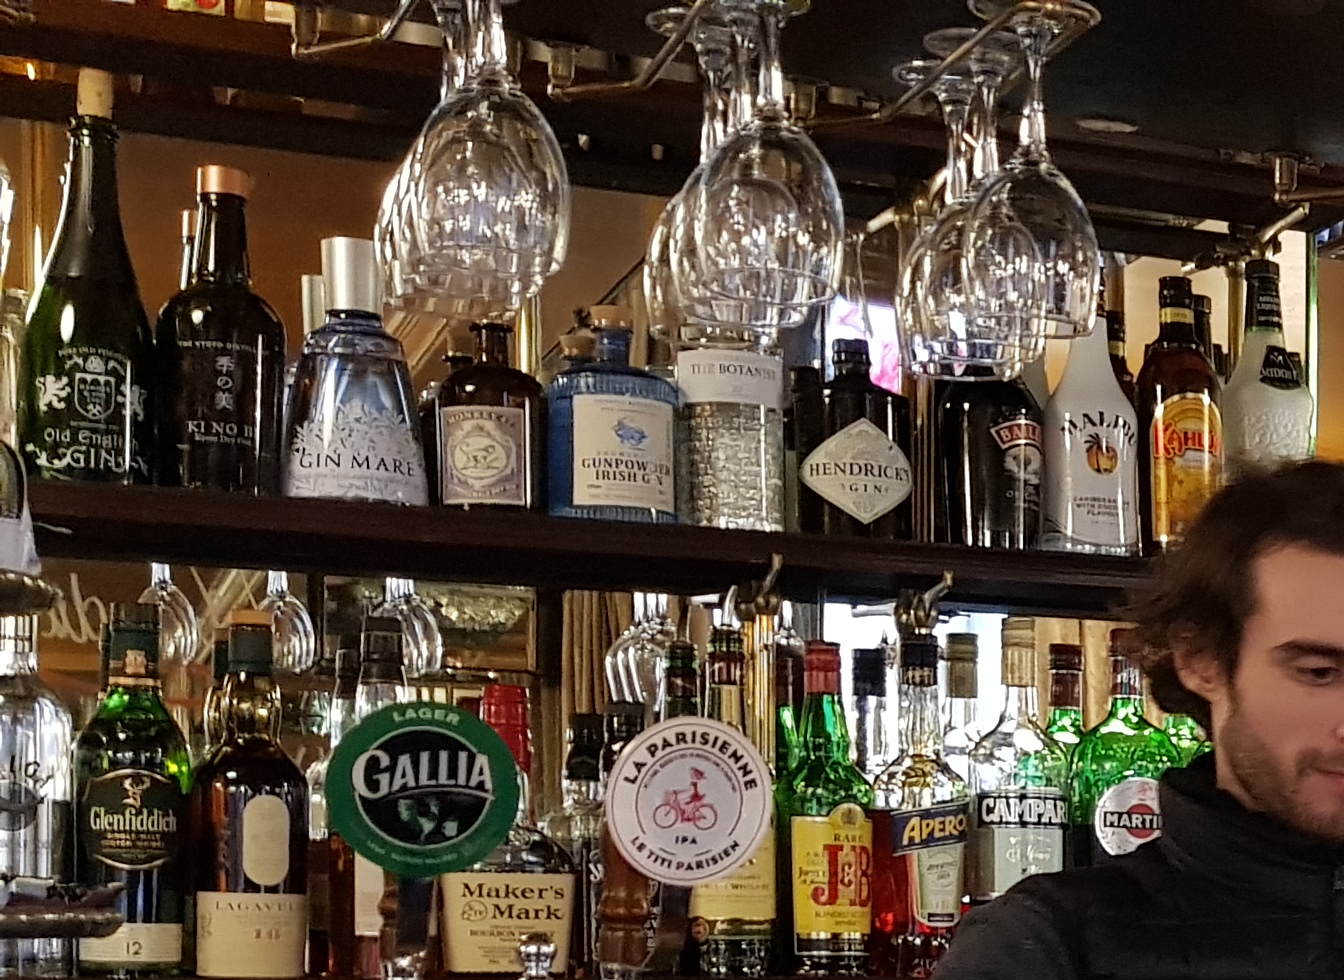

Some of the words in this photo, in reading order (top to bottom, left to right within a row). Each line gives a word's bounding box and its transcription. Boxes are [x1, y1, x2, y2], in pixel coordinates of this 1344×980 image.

[719, 364, 776, 379] BOTANIST
[78, 428, 140, 452] Englih
[68, 445, 116, 470] GIN
[300, 451, 342, 469] GIN
[350, 454, 415, 477] MARE
[595, 469, 637, 483] IRISH
[850, 484, 883, 495] GIN
[393, 707, 462, 727] LAGER
[623, 759, 648, 787] LA
[645, 730, 759, 792] PARISIENNE
[351, 748, 494, 800] GALLIA
[90, 806, 177, 832] Glenfiddich
[674, 834, 699, 846] IPA
[630, 836, 648, 854] LE
[646, 849, 672, 871] TITI
[674, 840, 742, 872] PARISIEN
[810, 843, 871, 908] J&B
[461, 882, 565, 900] Maker's
[490, 903, 565, 920] Mark
[125, 940, 143, 956] 12
